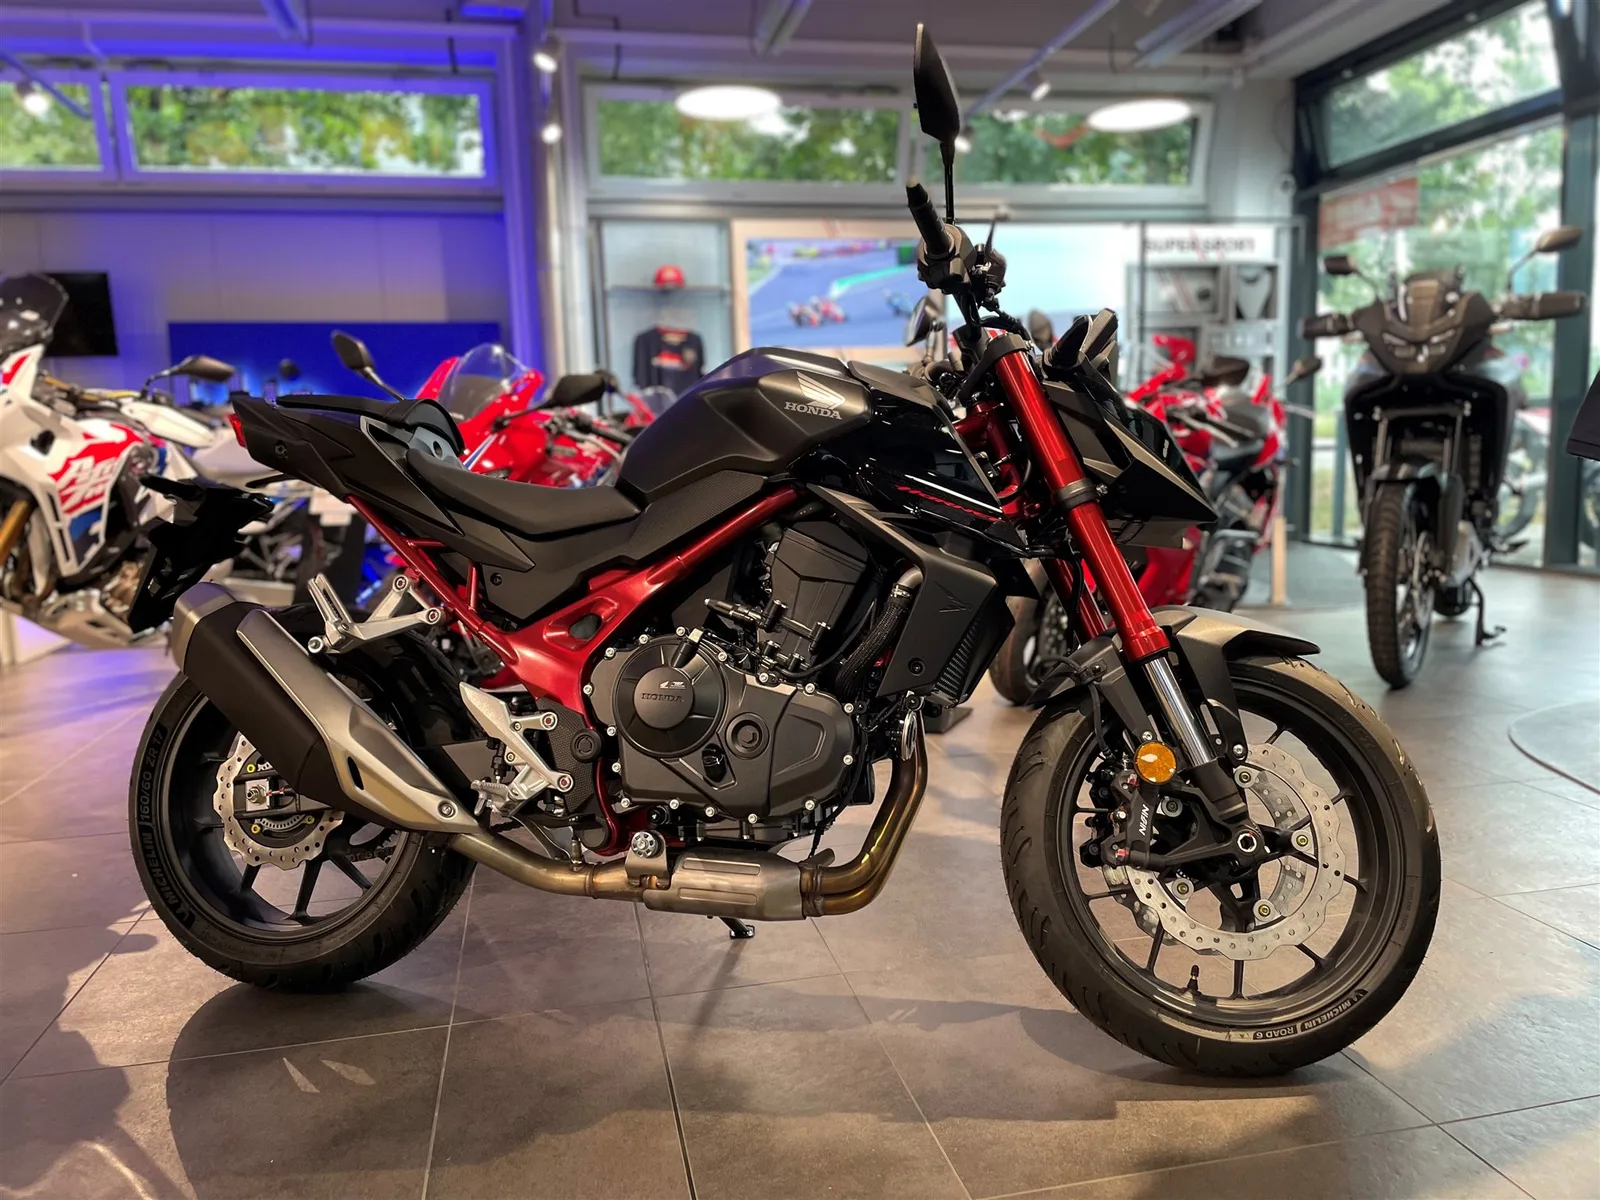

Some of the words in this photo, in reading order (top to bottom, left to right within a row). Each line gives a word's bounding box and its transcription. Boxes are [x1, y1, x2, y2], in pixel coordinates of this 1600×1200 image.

[1204, 236, 1255, 252] SPORT
[784, 401, 843, 420] HONDA
[641, 692, 685, 703] HONDA
[151, 729, 164, 745] 17
[145, 747, 159, 768] ZR
[139, 771, 153, 821] 160/60
[141, 832, 180, 905] MICHELIN
[1304, 1000, 1352, 1030] MICHELIN
[1265, 1026, 1294, 1039] ROAD
